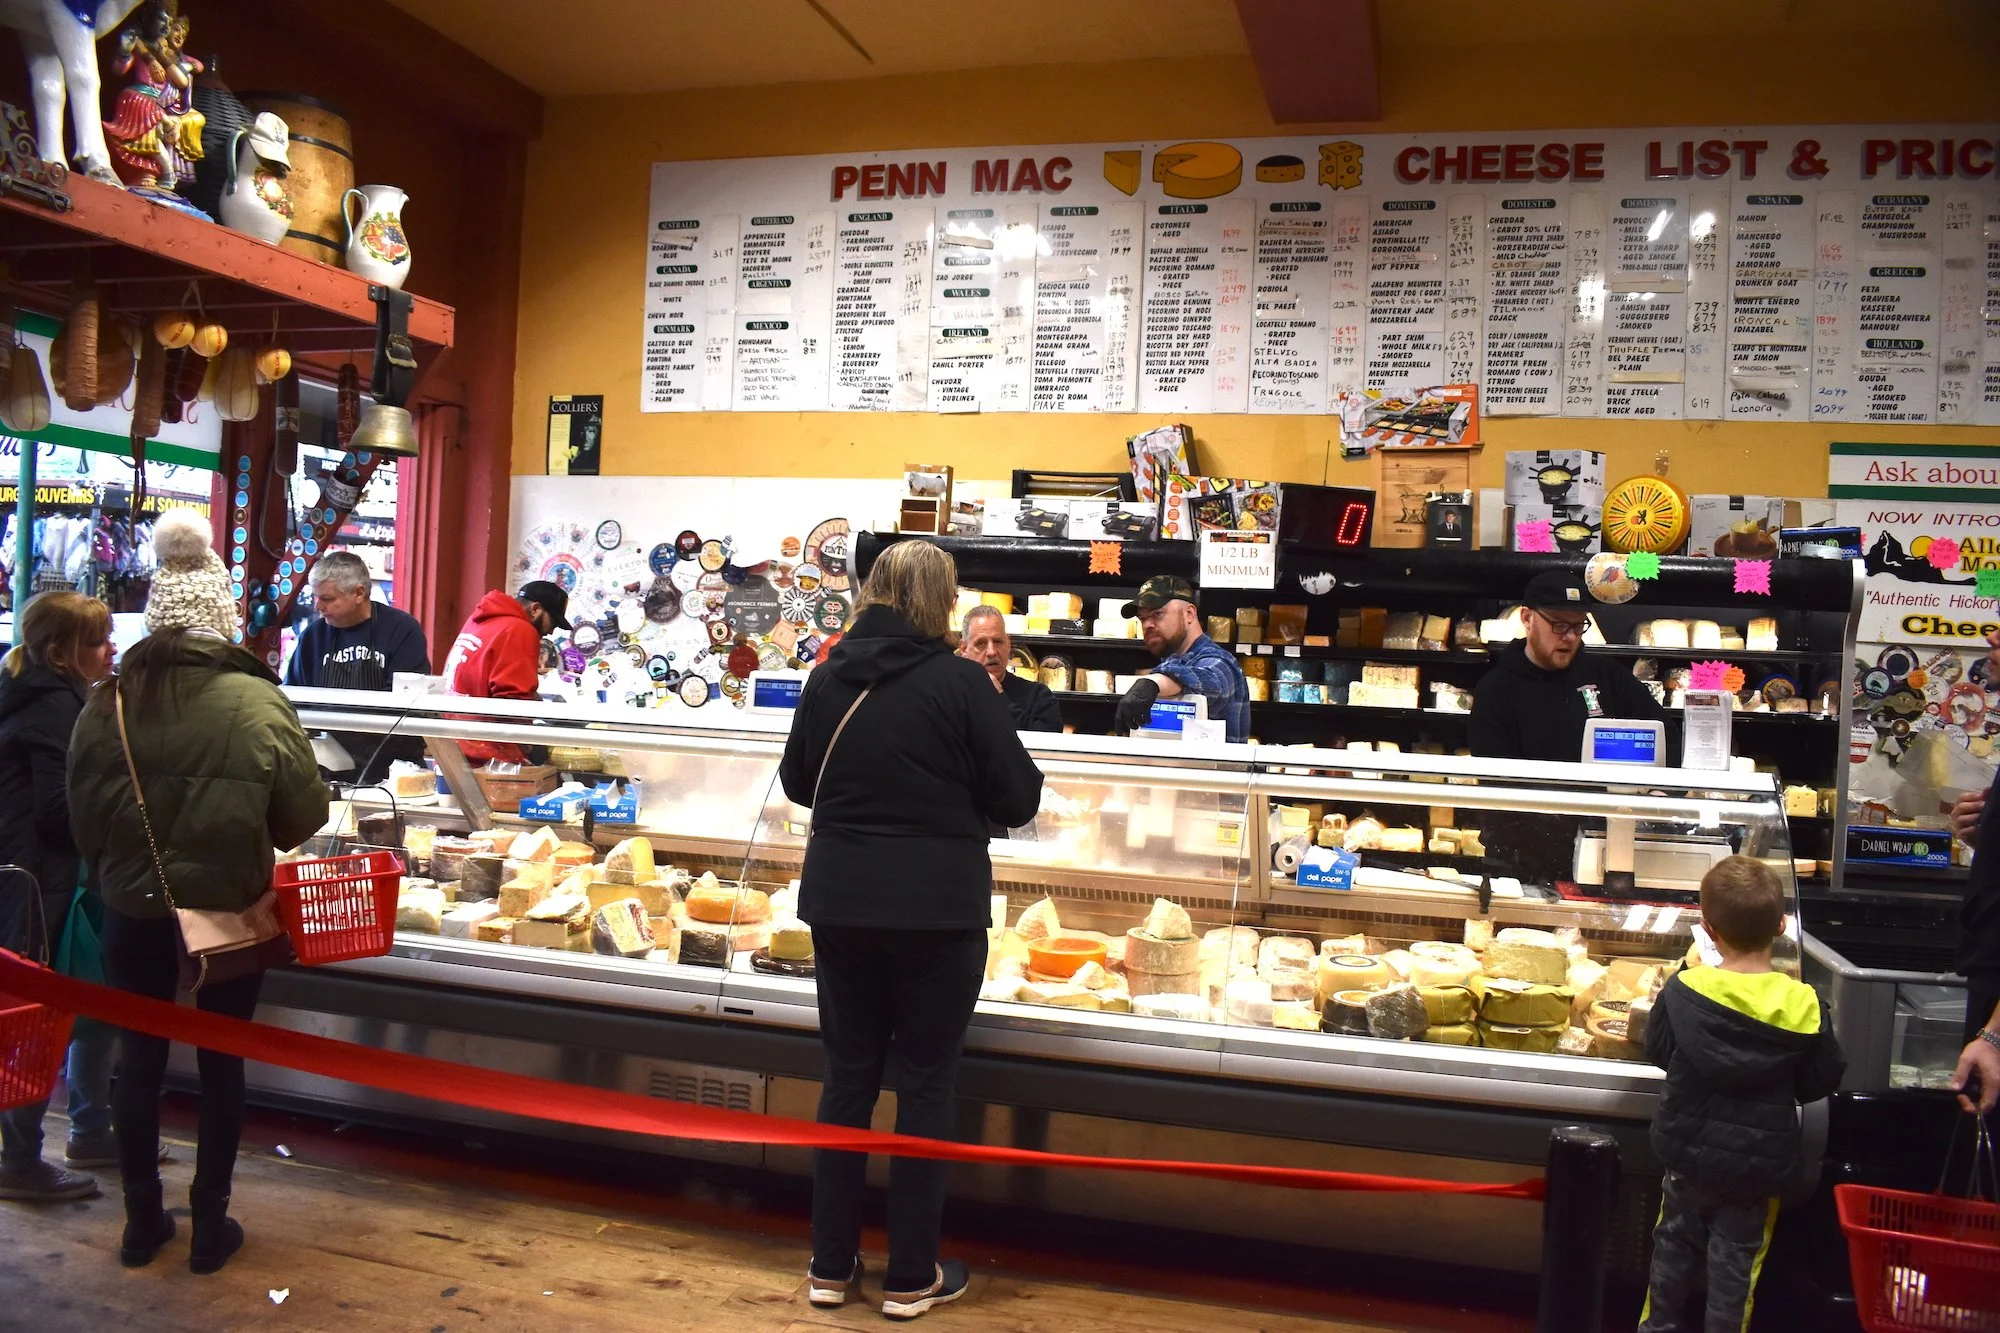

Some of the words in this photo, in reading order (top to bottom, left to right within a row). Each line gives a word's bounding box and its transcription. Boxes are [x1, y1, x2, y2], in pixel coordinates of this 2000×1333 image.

[833, 162, 947, 199] PENN
[972, 157, 1073, 193] MAC
[1396, 143, 1605, 182] CHEESE
[1648, 140, 1768, 179] LIST
[1791, 140, 1831, 178] &
[1507, 199, 1550, 208] DOMESTIC
[1758, 196, 1790, 204] SPAIN
[1170, 205, 1196, 214] ITALY
[1282, 203, 1309, 212] ITALY
[1388, 201, 1430, 210] DOMESTIC
[1061, 207, 1088, 216] ITALY
[853, 212, 887, 221] ENGLAND
[1489, 216, 1525, 224] CHEDDAR
[1862, 213, 1911, 221] CAMBOZOLA
[1373, 219, 1413, 227] AMERICAN
[1736, 233, 1782, 241] MANCHEGO
[1259, 239, 1292, 247] RASHERA
[1372, 245, 1421, 253] GORGONZOLA
[662, 265, 691, 274] CANADA
[1149, 264, 1182, 272] PECORINO
[1876, 268, 1920, 277] GREECE
[750, 280, 788, 288] ARGENTINA
[1407, 280, 1443, 288] MEUNSTER
[951, 289, 982, 297] WALES
[1258, 285, 1288, 293] ROBIOLA
[1861, 295, 1900, 303] GRAVIERA
[1620, 304, 1645, 312] AMISH
[1650, 304, 1670, 312] BABY
[1734, 307, 1779, 315] PIMENTINO
[1182, 315, 1211, 323] GINEPRO
[1488, 314, 1517, 322] COJACK
[1620, 313, 1670, 321] GUGGISBERG
[1860, 314, 1931, 322] KAFALOGRAVIERA
[657, 325, 691, 333] DENMARK
[752, 322, 782, 330] MEXICO
[1619, 322, 1653, 330] SMOKED
[948, 328, 983, 337] IRELAND
[1873, 340, 1917, 349] HOLLAND
[1254, 348, 1298, 357] STELVIO
[1369, 369, 1409, 377] MEUNSTER
[1607, 388, 1628, 396] BLUE
[1631, 388, 1659, 396] STELLA
[1032, 401, 1065, 411] PIAVE
[1606, 398, 1630, 406] BRICK
[551, 401, 599, 413] COLLIER'S
[1606, 407, 1631, 415] BRICK
[1634, 407, 1655, 415] AGED
[1731, 403, 1772, 414] Leonora
[1865, 461, 1919, 483] Ask
[1927, 462, 2000, 484] abou
[1867, 511, 1923, 525] NOW
[1932, 513, 2000, 527] INTRO
[1336, 503, 1368, 545] 0
[1221, 547, 1237, 559] 1/2
[1241, 548, 1259, 559] LB
[1960, 556, 2000, 571] Mo
[1207, 564, 1270, 577] MINIMUM
[1866, 591, 1940, 607] "Authentic
[322, 646, 355, 666] CAST
[1861, 839, 1891, 852] DARNEL
[1893, 841, 1912, 855] WRAP
[1913, 844, 1929, 855] PRO
[1321, 875, 1343, 883] paper
